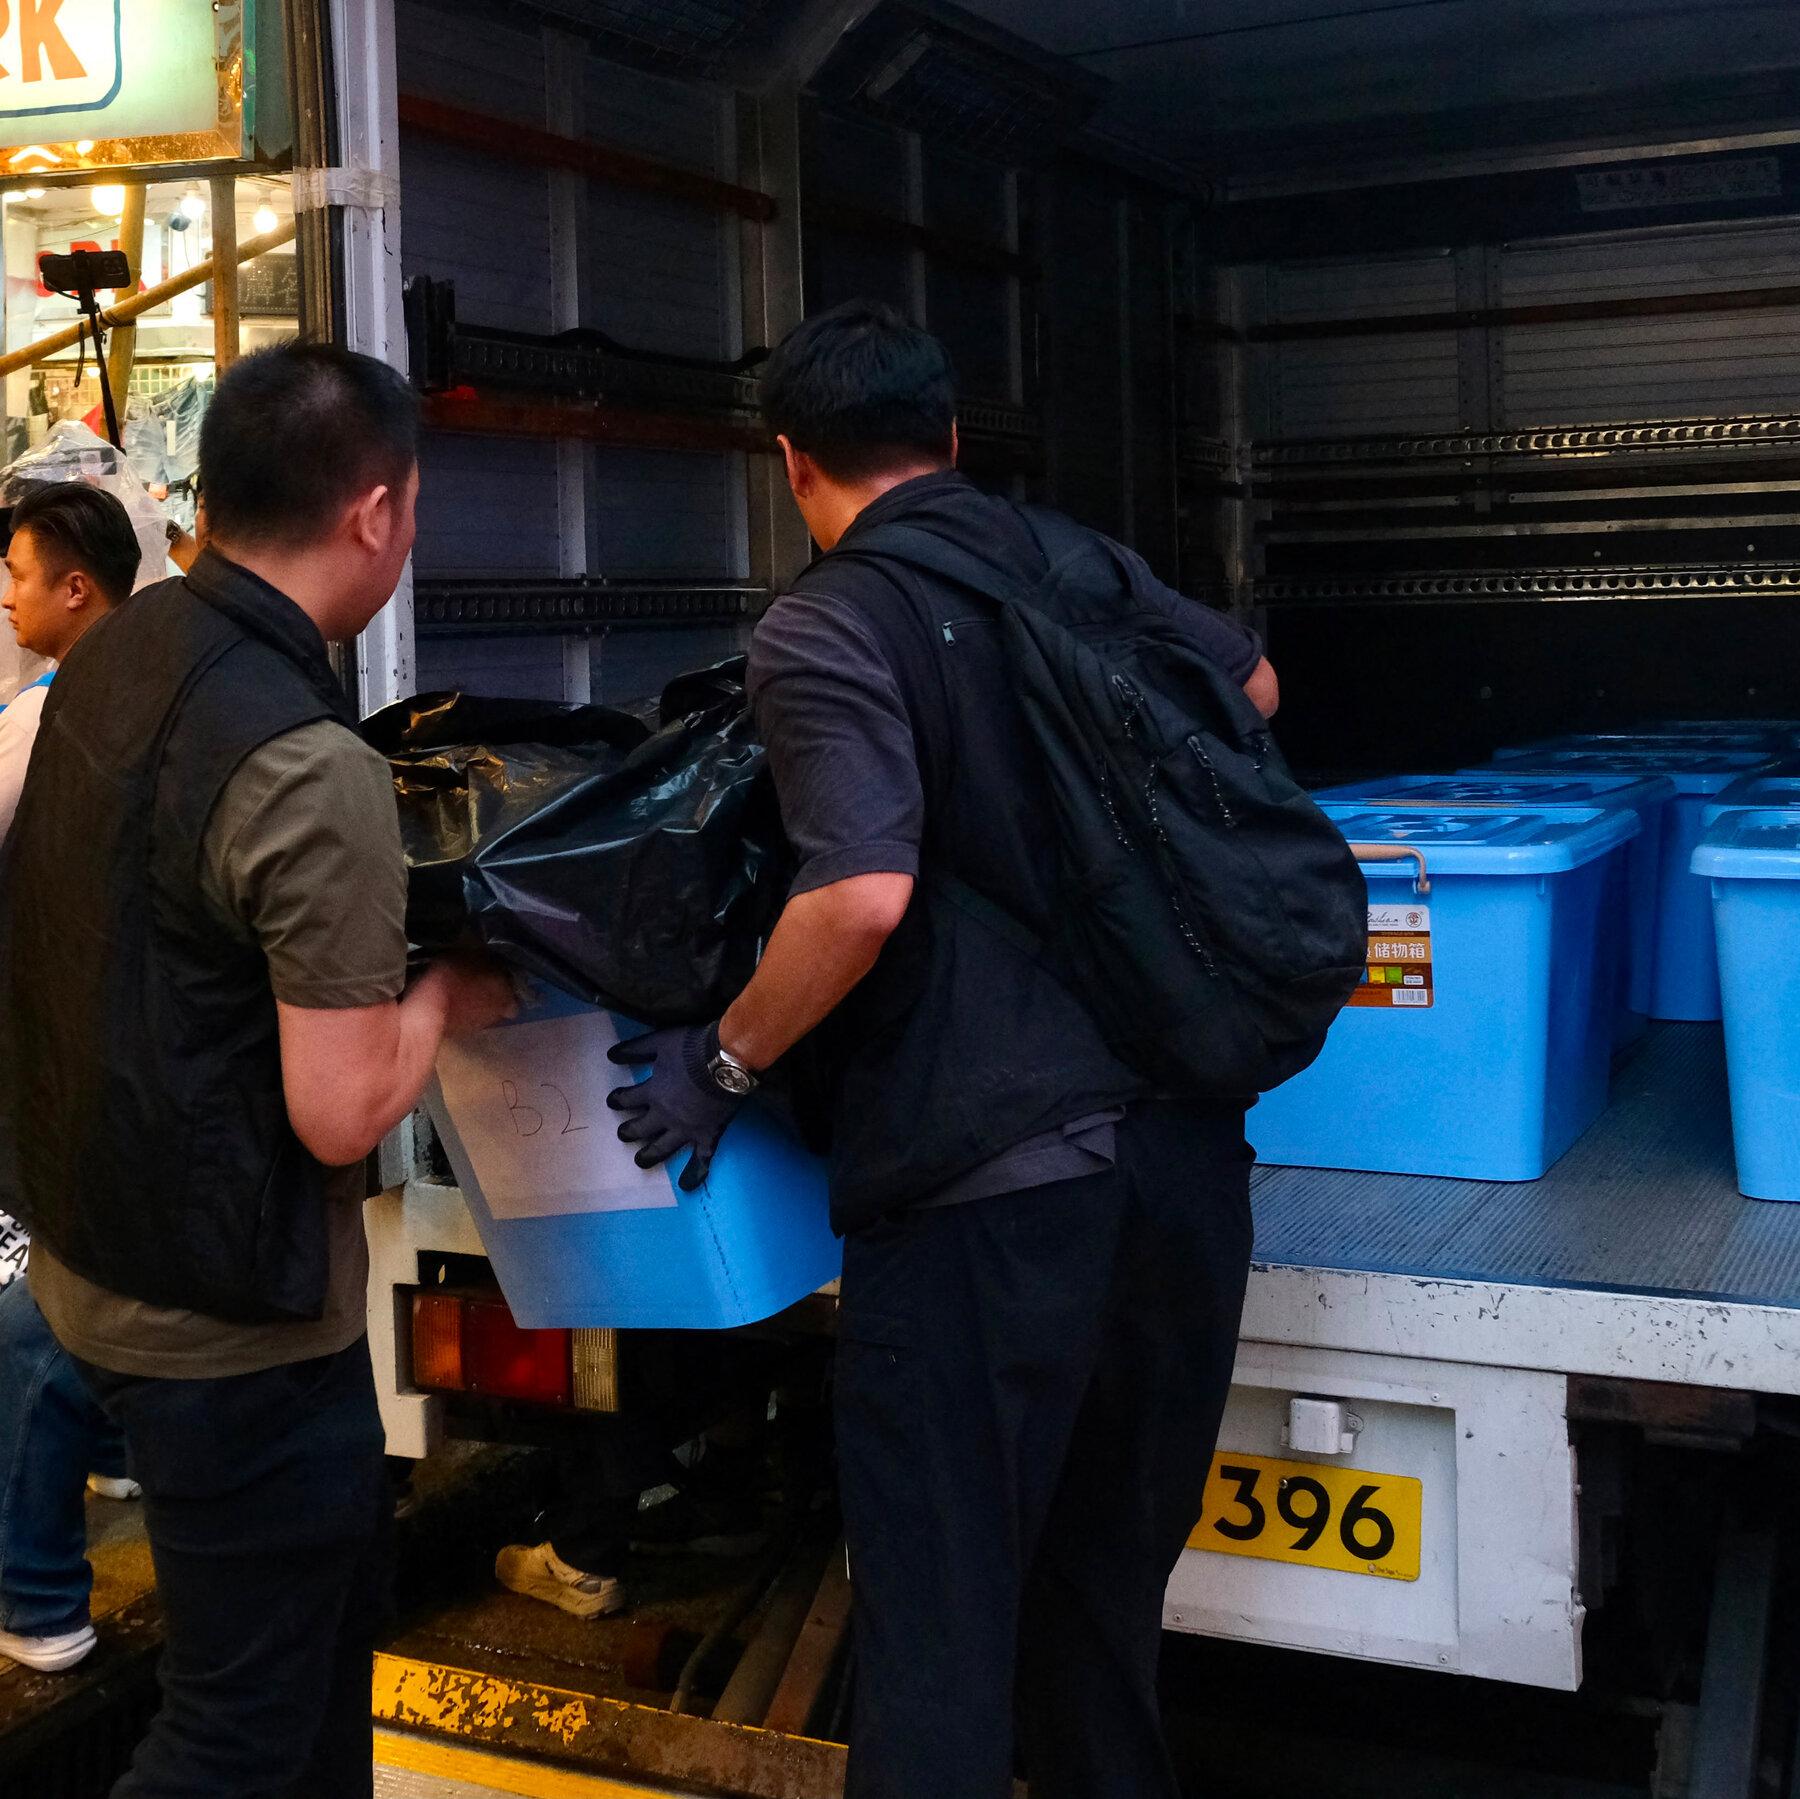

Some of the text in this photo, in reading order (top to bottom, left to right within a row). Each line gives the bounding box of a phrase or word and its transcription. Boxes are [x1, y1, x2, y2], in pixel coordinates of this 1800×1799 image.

[0, 0, 88, 83] K
[1367, 943, 1425, 959] 储物箱
[501, 1080, 589, 1137] B2
[1213, 1465, 1395, 1560] 396
